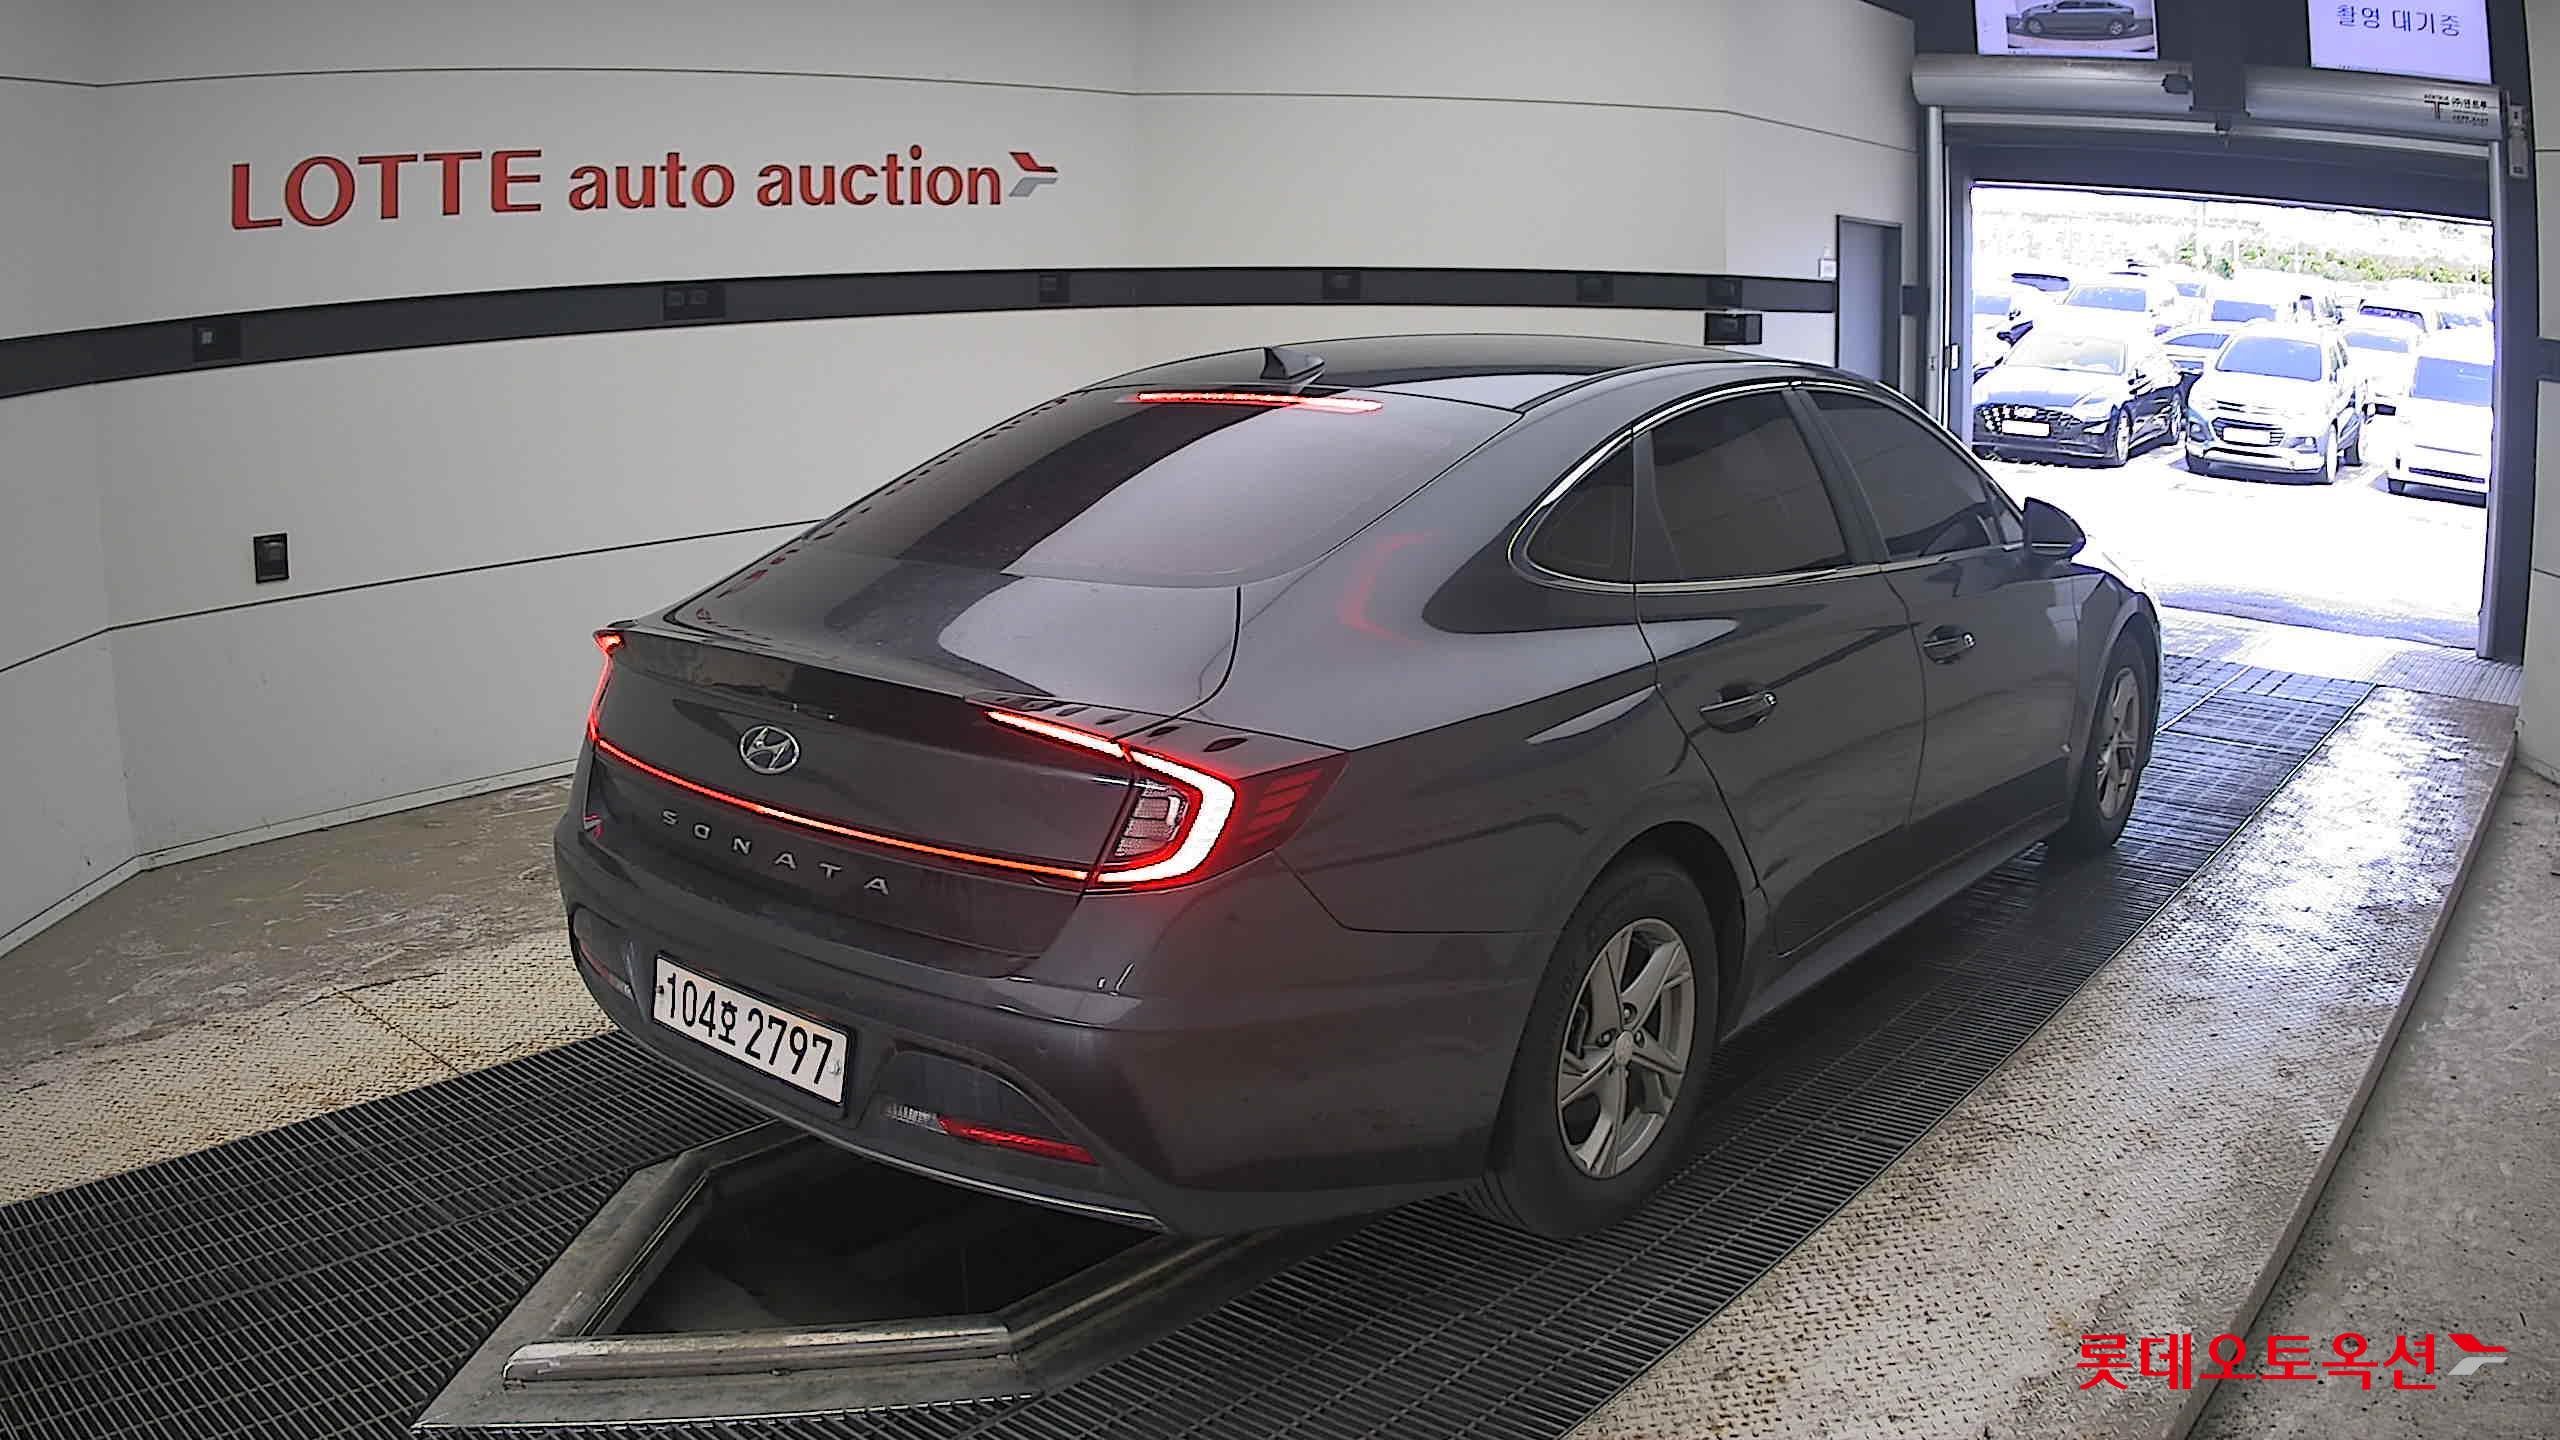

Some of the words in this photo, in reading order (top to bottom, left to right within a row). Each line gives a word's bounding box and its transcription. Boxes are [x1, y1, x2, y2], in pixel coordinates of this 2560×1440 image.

[2337, 3, 2381, 29] 촬영
[2391, 9, 2461, 37] 대기중
[231, 149, 541, 229] LOTTE
[568, 152, 736, 210] auto
[756, 145, 1002, 208] auction
[661, 808, 890, 897] SONATA
[744, 1007, 833, 1085] 2797
